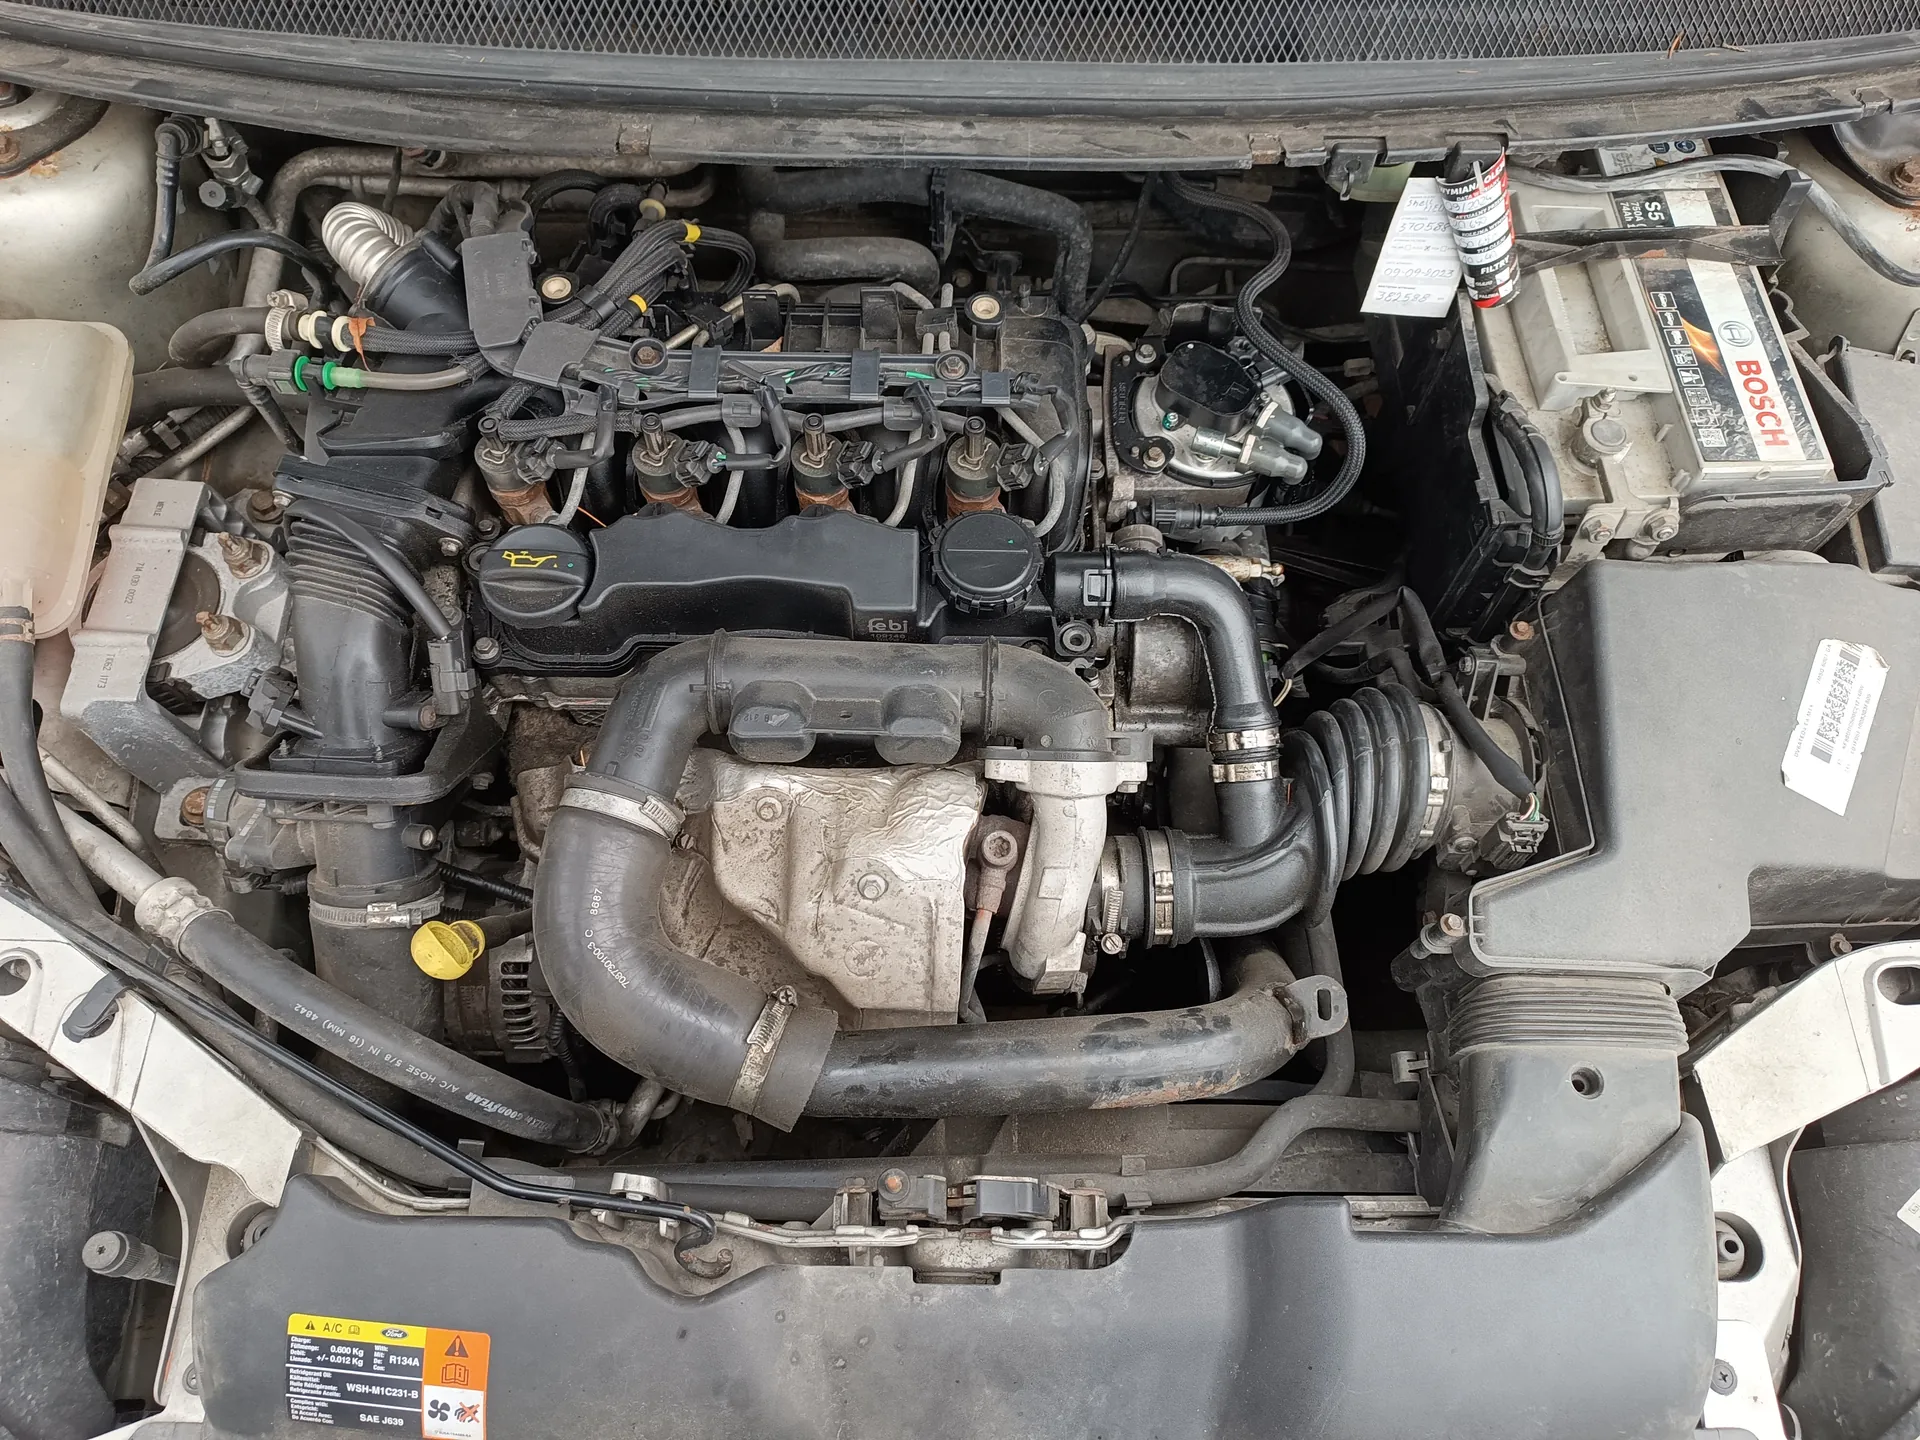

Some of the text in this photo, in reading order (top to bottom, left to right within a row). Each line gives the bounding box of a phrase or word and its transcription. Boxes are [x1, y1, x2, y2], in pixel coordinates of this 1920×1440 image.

[1440, 182, 1479, 195] WYMIAN
[1620, 201, 1634, 222] 74Ah
[1630, 201, 1645, 222] 750A
[1645, 201, 1665, 221] S5
[1481, 255, 1510, 275] FILTRY
[1735, 359, 1789, 447] BOSCH
[867, 617, 908, 633] febi
[584, 887, 630, 989] 708730100-3 C 8687
[293, 1003, 319, 1021] 4842
[322, 1018, 346, 1037] MM)
[349, 1034, 366, 1049] (16
[368, 1044, 381, 1057] IN
[384, 1052, 403, 1067] 5/8
[405, 1063, 437, 1084] HOSE
[438, 1079, 460, 1094] A/C
[464, 1091, 525, 1122] GOODYEAR
[323, 1322, 343, 1333] A/C
[384, 1328, 406, 1338] Ford
[290, 1336, 312, 1344] Charge:
[330, 1345, 364, 1357] 0.600 Kg
[316, 1354, 364, 1367] +/- 0.012 Kg
[389, 1355, 420, 1367] R134A
[346, 1382, 419, 1399] WSH-M1C231-B
[359, 1413, 404, 1426] SAE J639
